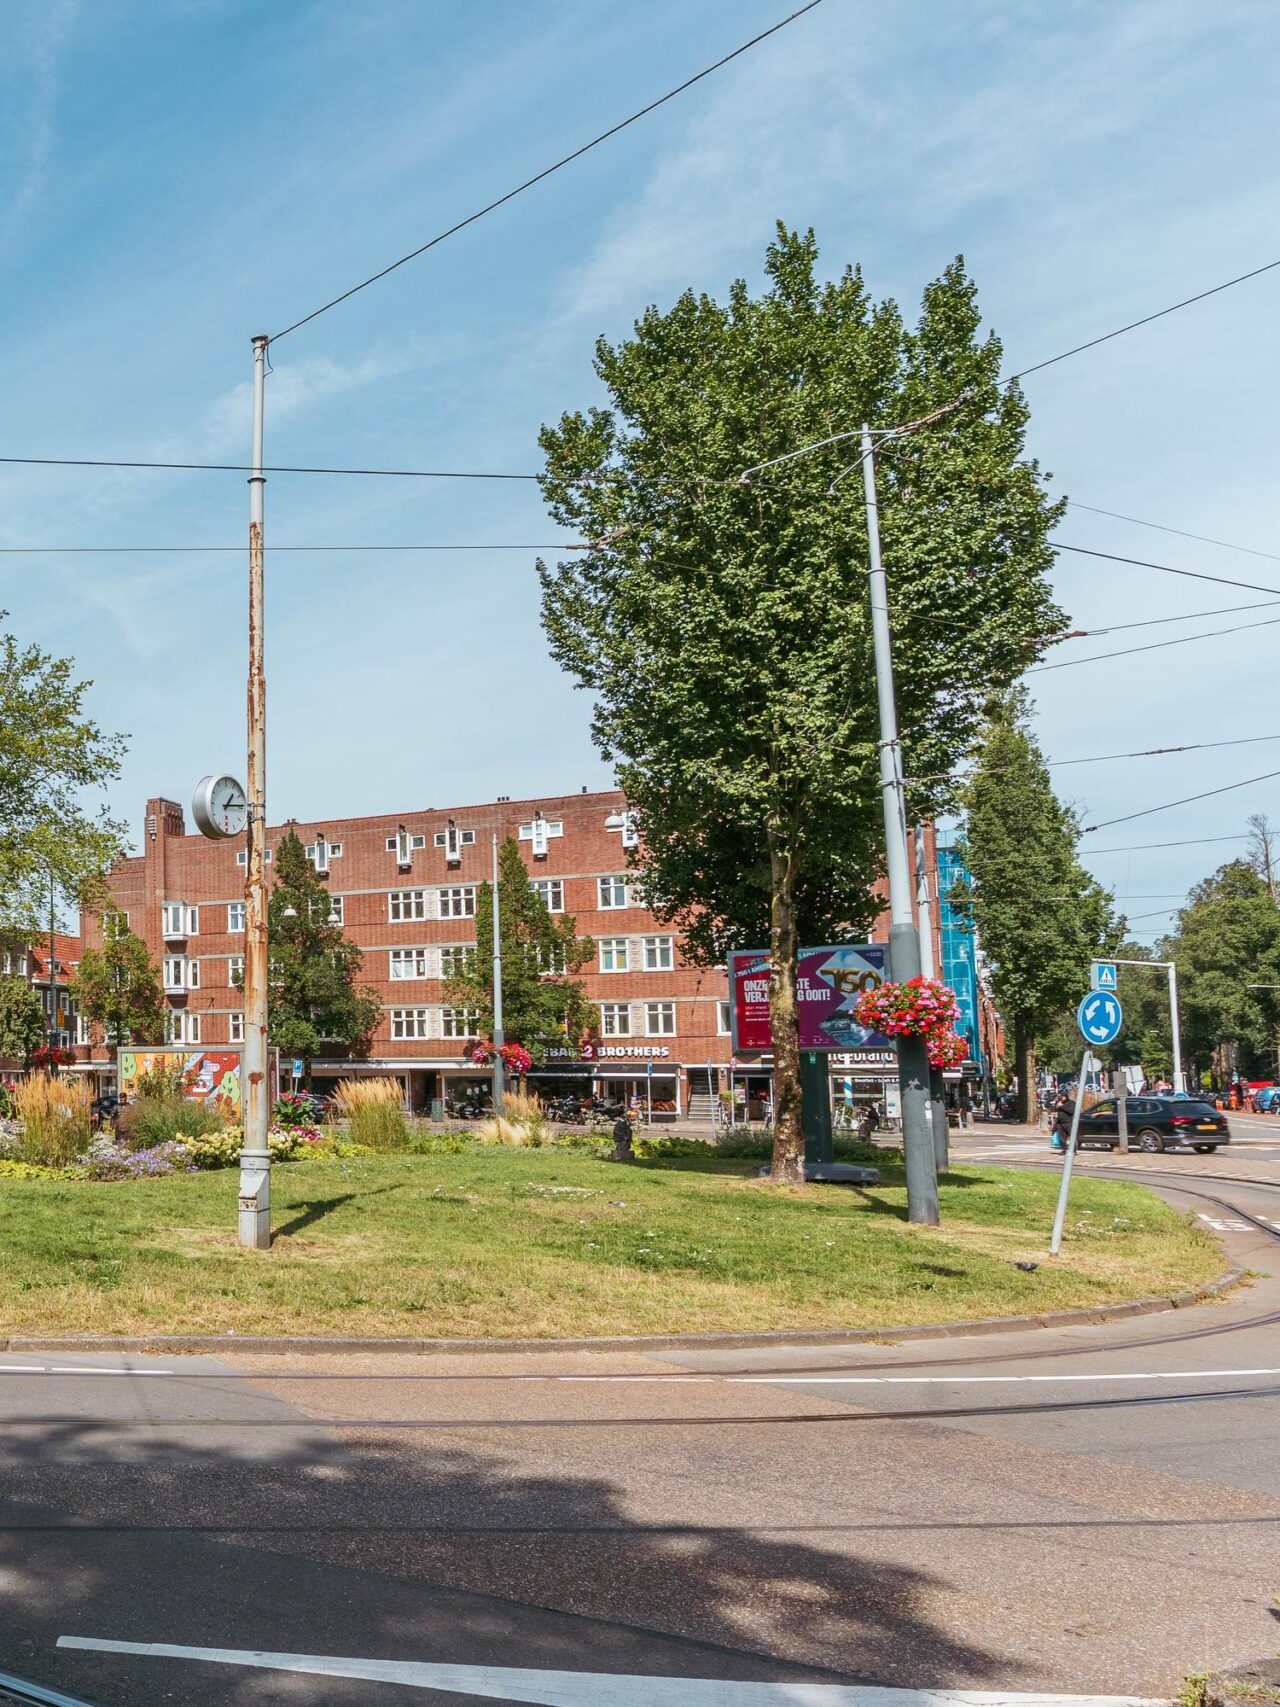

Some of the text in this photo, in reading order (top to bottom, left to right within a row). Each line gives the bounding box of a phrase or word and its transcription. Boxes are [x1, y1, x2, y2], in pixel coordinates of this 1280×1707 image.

[806, 989, 831, 1001] OOIT!
[581, 1045, 593, 1058] 2
[597, 1046, 670, 1057] BROTHERS
